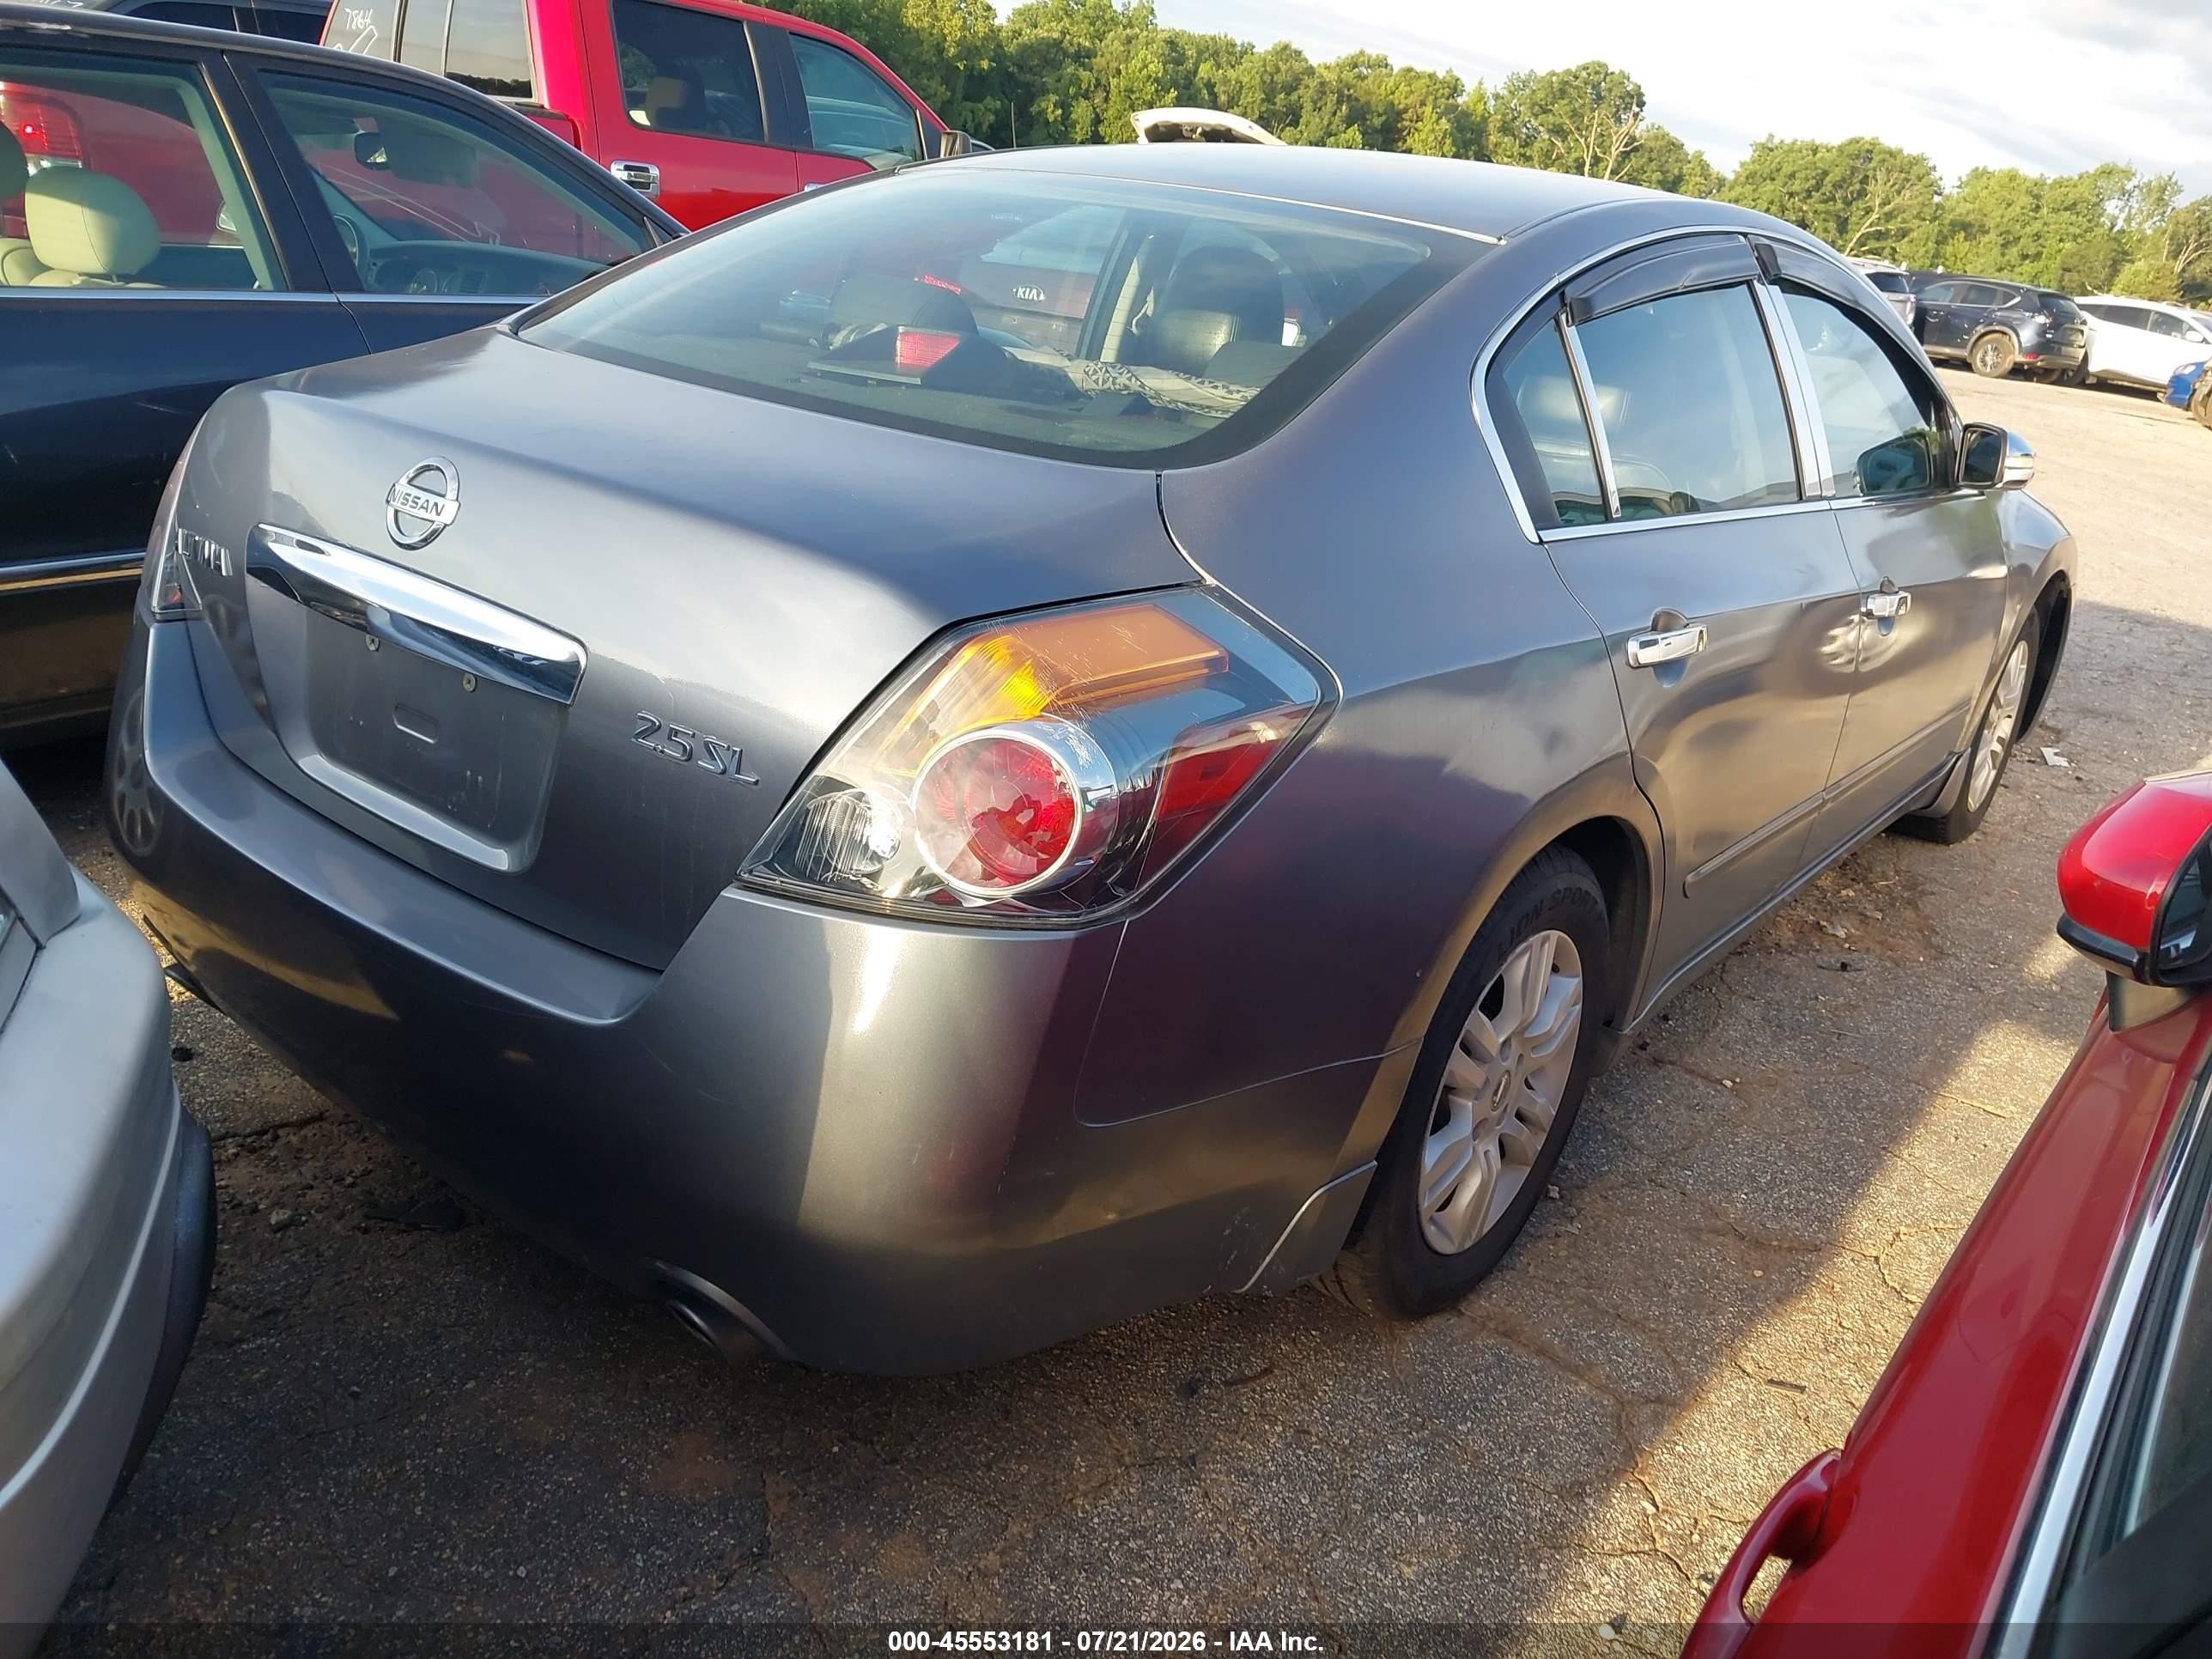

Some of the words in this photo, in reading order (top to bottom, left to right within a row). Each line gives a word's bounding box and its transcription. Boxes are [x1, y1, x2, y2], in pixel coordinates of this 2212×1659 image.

[343, 7, 373, 30] 7864
[1016, 286, 1038, 301] KIA
[388, 486, 446, 517] NISSAN
[630, 711, 694, 763] 2.5
[697, 736, 760, 786] SL
